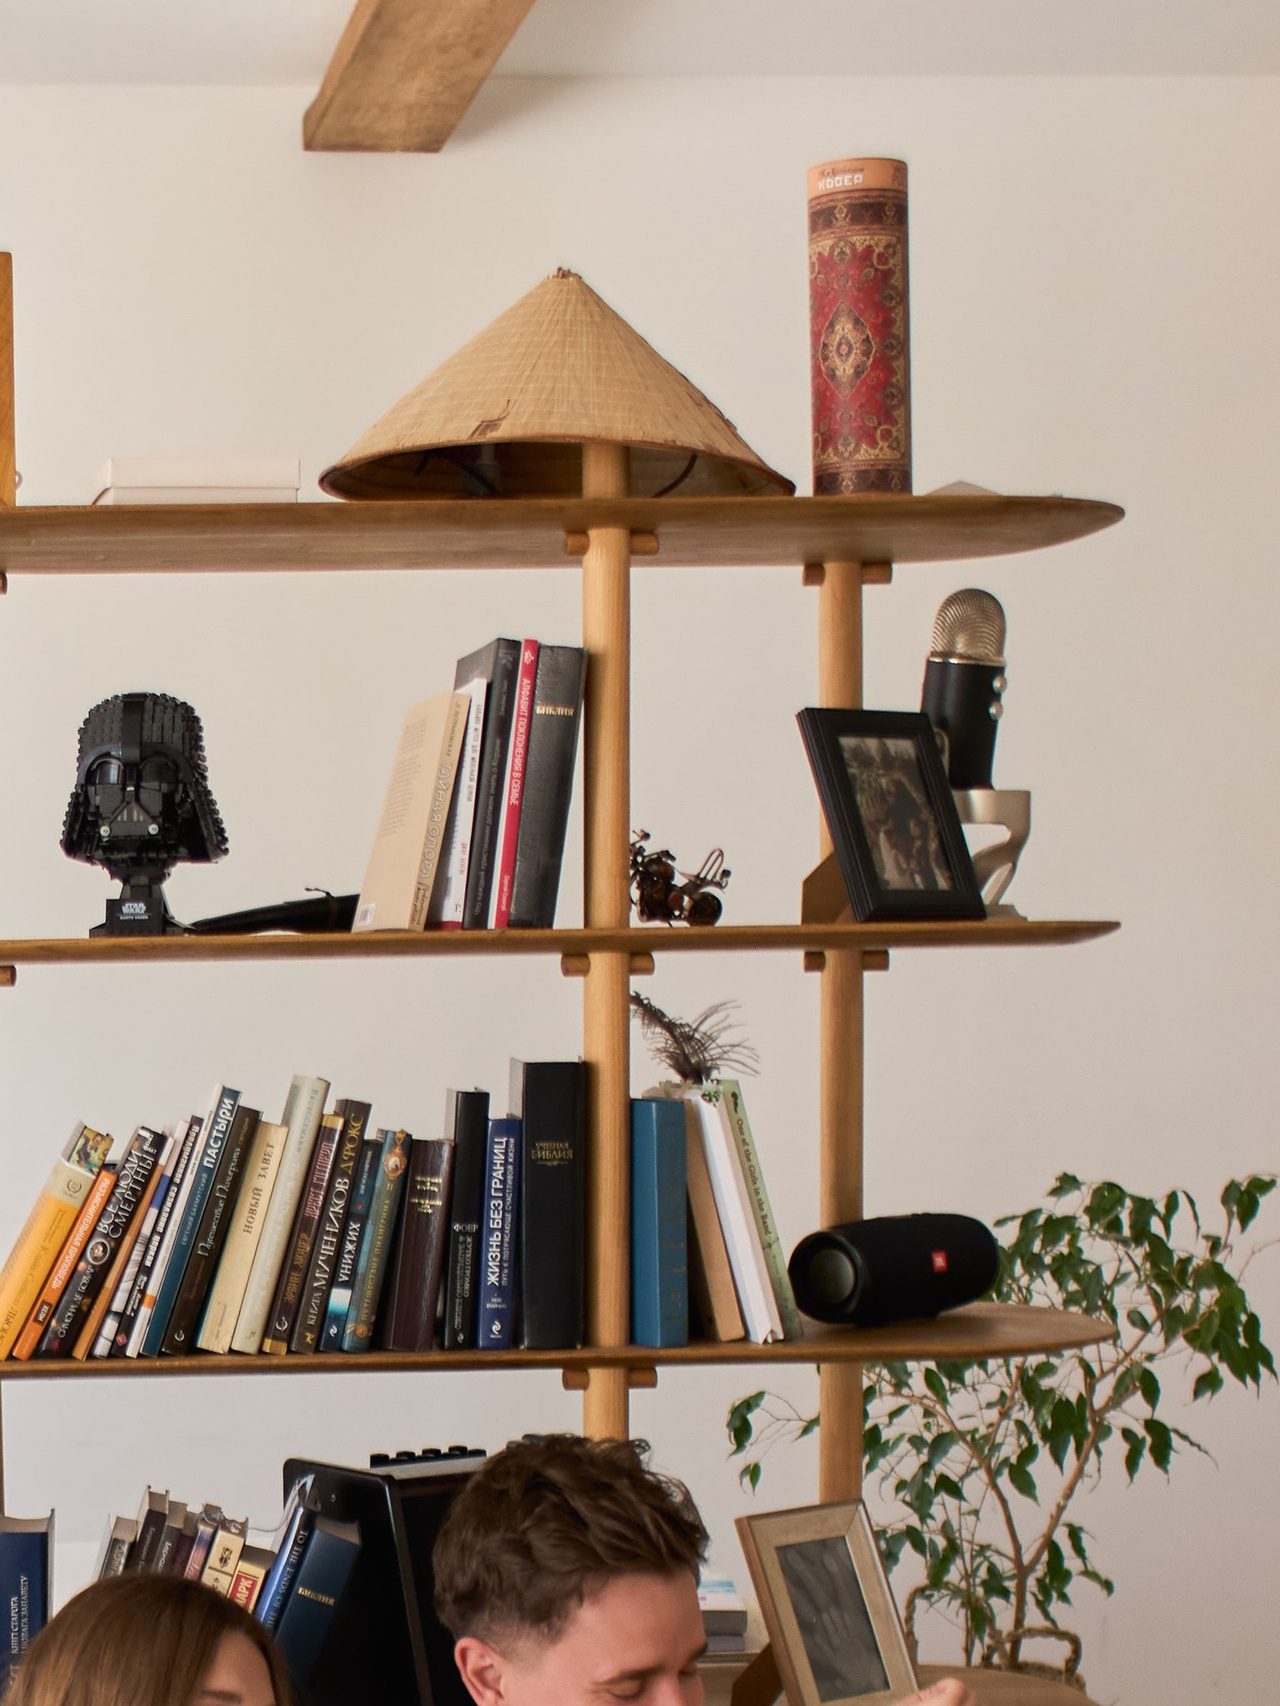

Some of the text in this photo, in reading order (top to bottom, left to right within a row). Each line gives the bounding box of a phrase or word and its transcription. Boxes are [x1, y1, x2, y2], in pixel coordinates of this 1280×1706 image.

[519, 678, 530, 715] АЛФАВИТ
[536, 705, 574, 717] БИБЛИЯ
[513, 717, 526, 770] ПОКЛОНЕНИЯ
[485, 796, 494, 824] должен
[509, 779, 520, 805] СЕМЬЕ
[418, 761, 454, 879] ТАЙНАЯ ОПОРА
[480, 825, 491, 869] христианин
[476, 871, 485, 900] каждый
[172, 1124, 199, 1184] Продуманное
[202, 1097, 238, 1168] ПАСТЫРИ
[506, 1138, 515, 1162] ЖИЗНИ
[531, 1150, 573, 1160] БИБЛИЯ
[95, 1148, 142, 1234] ВСЕ ЛЮДИ
[107, 1153, 154, 1239] СМЕРТНЫ
[240, 1141, 276, 1234] НОВЫЙ ЗАВЕТ
[502, 1164, 515, 1210] СЧАСТЛИВОЙ
[735, 1118, 772, 1235] One of the Girls in the Band
[71, 1177, 111, 1247] РАЗЪЯСНИТЕЛЬНАЯ
[155, 1185, 177, 1233] созидание
[180, 1215, 196, 1245] ЕВГЕНИЙ
[188, 1172, 209, 1216] БАХМУТСКИЙ
[196, 1197, 229, 1257] Путешествие
[214, 1145, 244, 1199] Пилигрима
[487, 1136, 508, 1285] ЖИЗНЬ БЕЗ ГРАНИЦ
[143, 1234, 161, 1267] церкви
[306, 1177, 351, 1325] КНИГА МУЧЕНИКОВ
[453, 1223, 478, 1233] ФОЕР
[501, 1212, 513, 1260] ПОТРЯСАЮЩЕ
[50, 1245, 78, 1290] ПРОПОВЕДЬ
[336, 1221, 361, 1283] ХИЖИНА
[360, 1199, 390, 1320] ПУТЕШЕСТВИЕ ПИЛИГРИМА
[284, 1272, 300, 1303] ЭРВИН
[56, 1304, 78, 1338] СИМОНА
[71, 1291, 83, 1304] ДЕ
[288, 1545, 302, 1565] THE
[17, 1575, 31, 1617] ЗАПАВЕТУ
[273, 1595, 285, 1609] OF
[277, 1566, 295, 1595] ENDS
[8, 1596, 20, 1632] СТАРОГА
